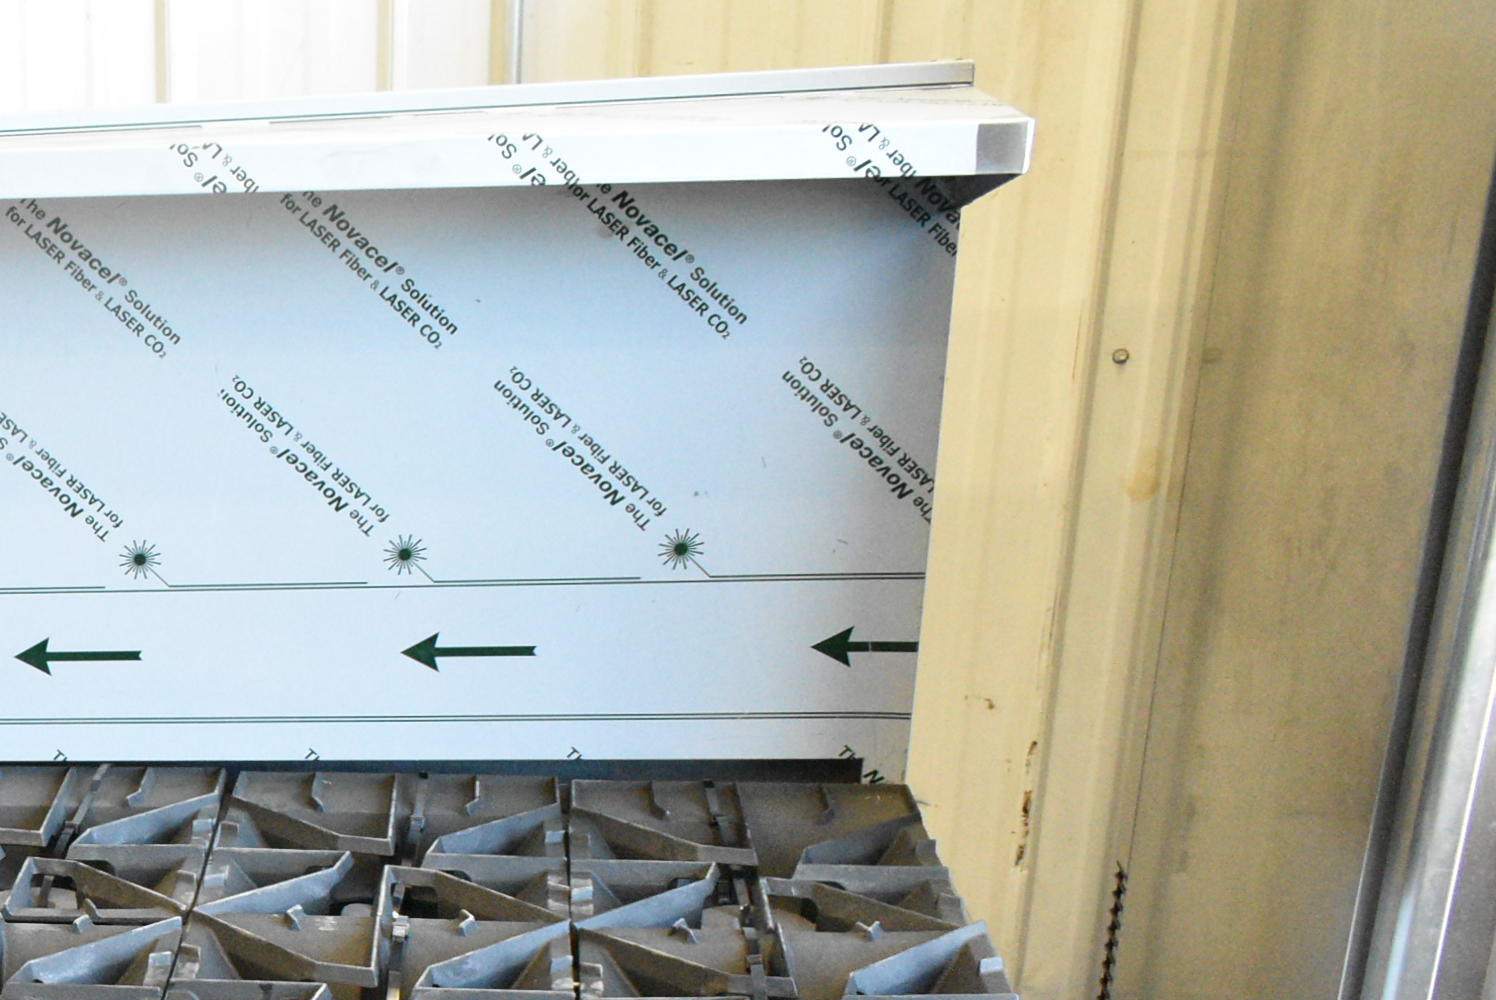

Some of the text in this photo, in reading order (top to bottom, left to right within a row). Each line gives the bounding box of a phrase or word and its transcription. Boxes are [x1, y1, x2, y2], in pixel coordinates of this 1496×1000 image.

[888, 183, 932, 227] LASER
[4, 205, 27, 227] for
[23, 223, 66, 265] LASER
[63, 259, 98, 292] Fiber
[103, 296, 145, 338] LASER
[279, 195, 303, 215] for
[298, 210, 342, 253] LASER
[338, 248, 374, 282] Fiber
[378, 285, 421, 328] LASER
[586, 197, 630, 242] LASER
[626, 235, 662, 270] Fiber
[666, 274, 710, 318] LASER
[400, 278, 458, 336] Solution
[689, 266, 748, 325] Solution
[124, 289, 181, 345] Solution
[253, 396, 294, 437] LASER
[493, 379, 550, 436] Solution
[530, 387, 572, 429] LASER
[781, 370, 839, 428] Solution
[819, 378, 863, 420] LASER
[300, 440, 334, 472] Fiber
[577, 433, 611, 465] Fiber
[866, 424, 902, 457] Fiber
[34, 448, 68, 479] Fiber
[608, 460, 650, 501] LASER
[65, 474, 106, 513] LASER
[330, 467, 372, 507] LASER
[645, 497, 668, 518] for
[84, 514, 110, 543] The
[103, 509, 124, 529] for
[349, 509, 375, 537] The
[368, 503, 390, 524] for
[624, 502, 651, 532] The
